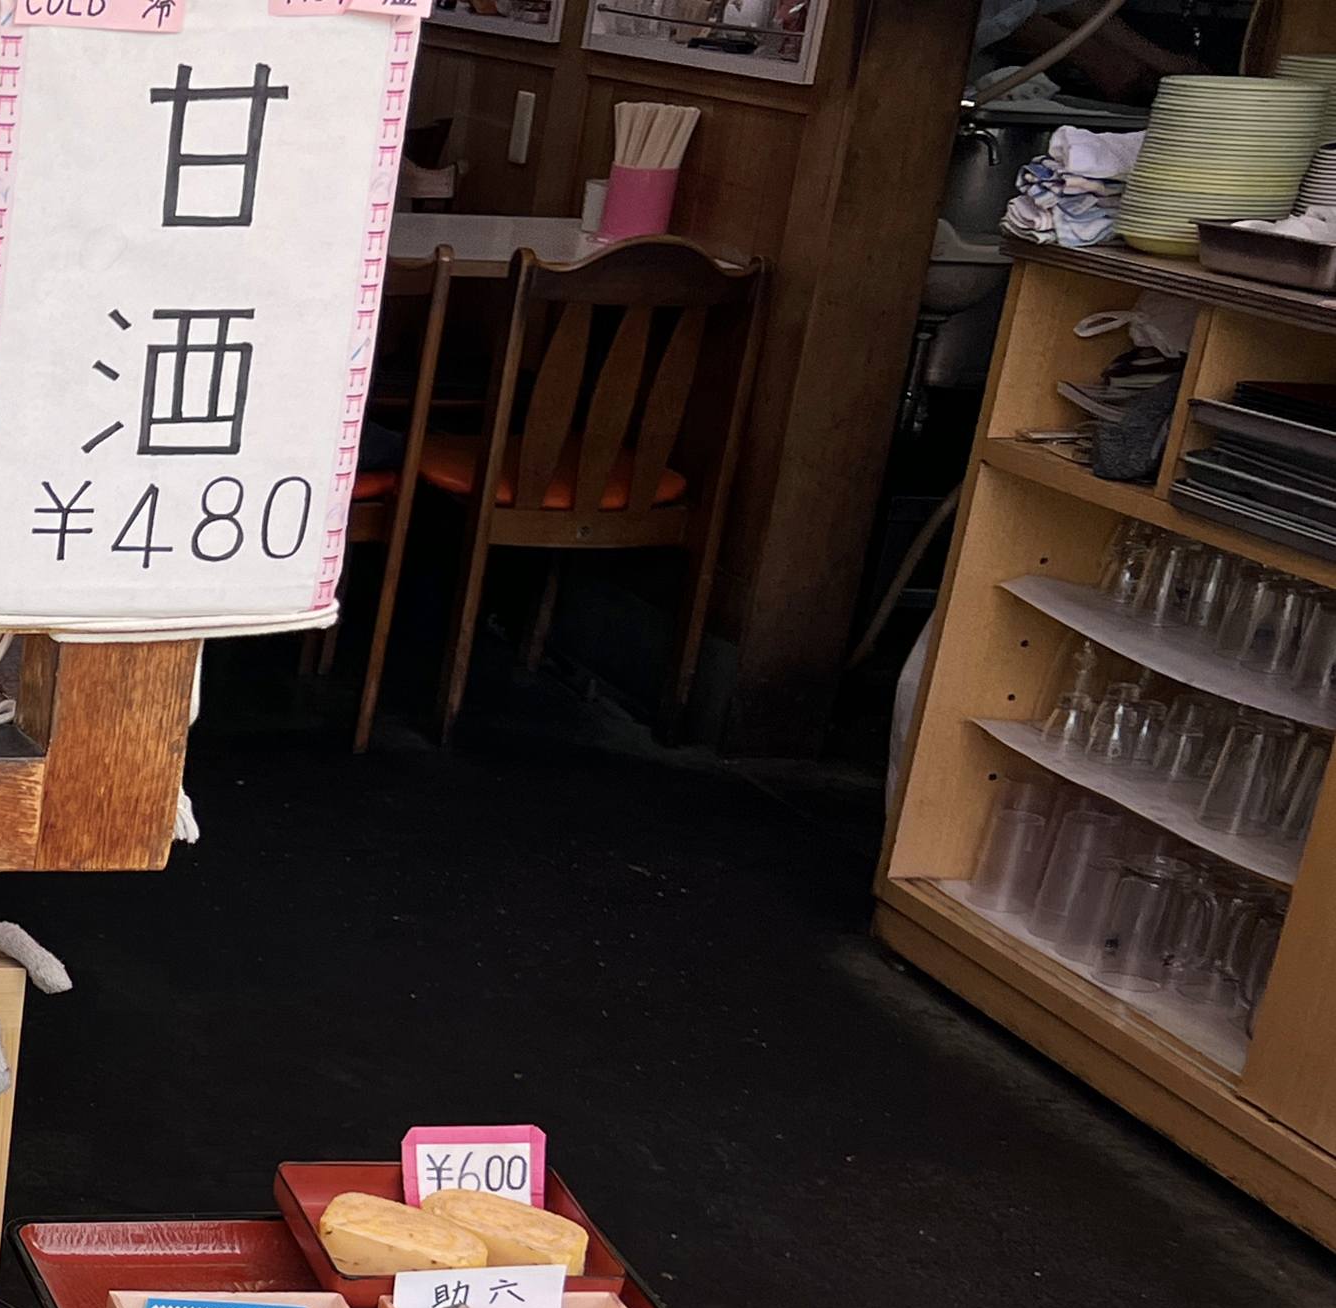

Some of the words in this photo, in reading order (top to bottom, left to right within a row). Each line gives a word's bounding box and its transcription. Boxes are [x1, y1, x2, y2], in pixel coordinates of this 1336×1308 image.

[81, 63, 289, 456] 甘酒
[31, 475, 311, 569] ¥480
[426, 1151, 527, 1192] ¥600
[432, 1279, 526, 1308] 助六
